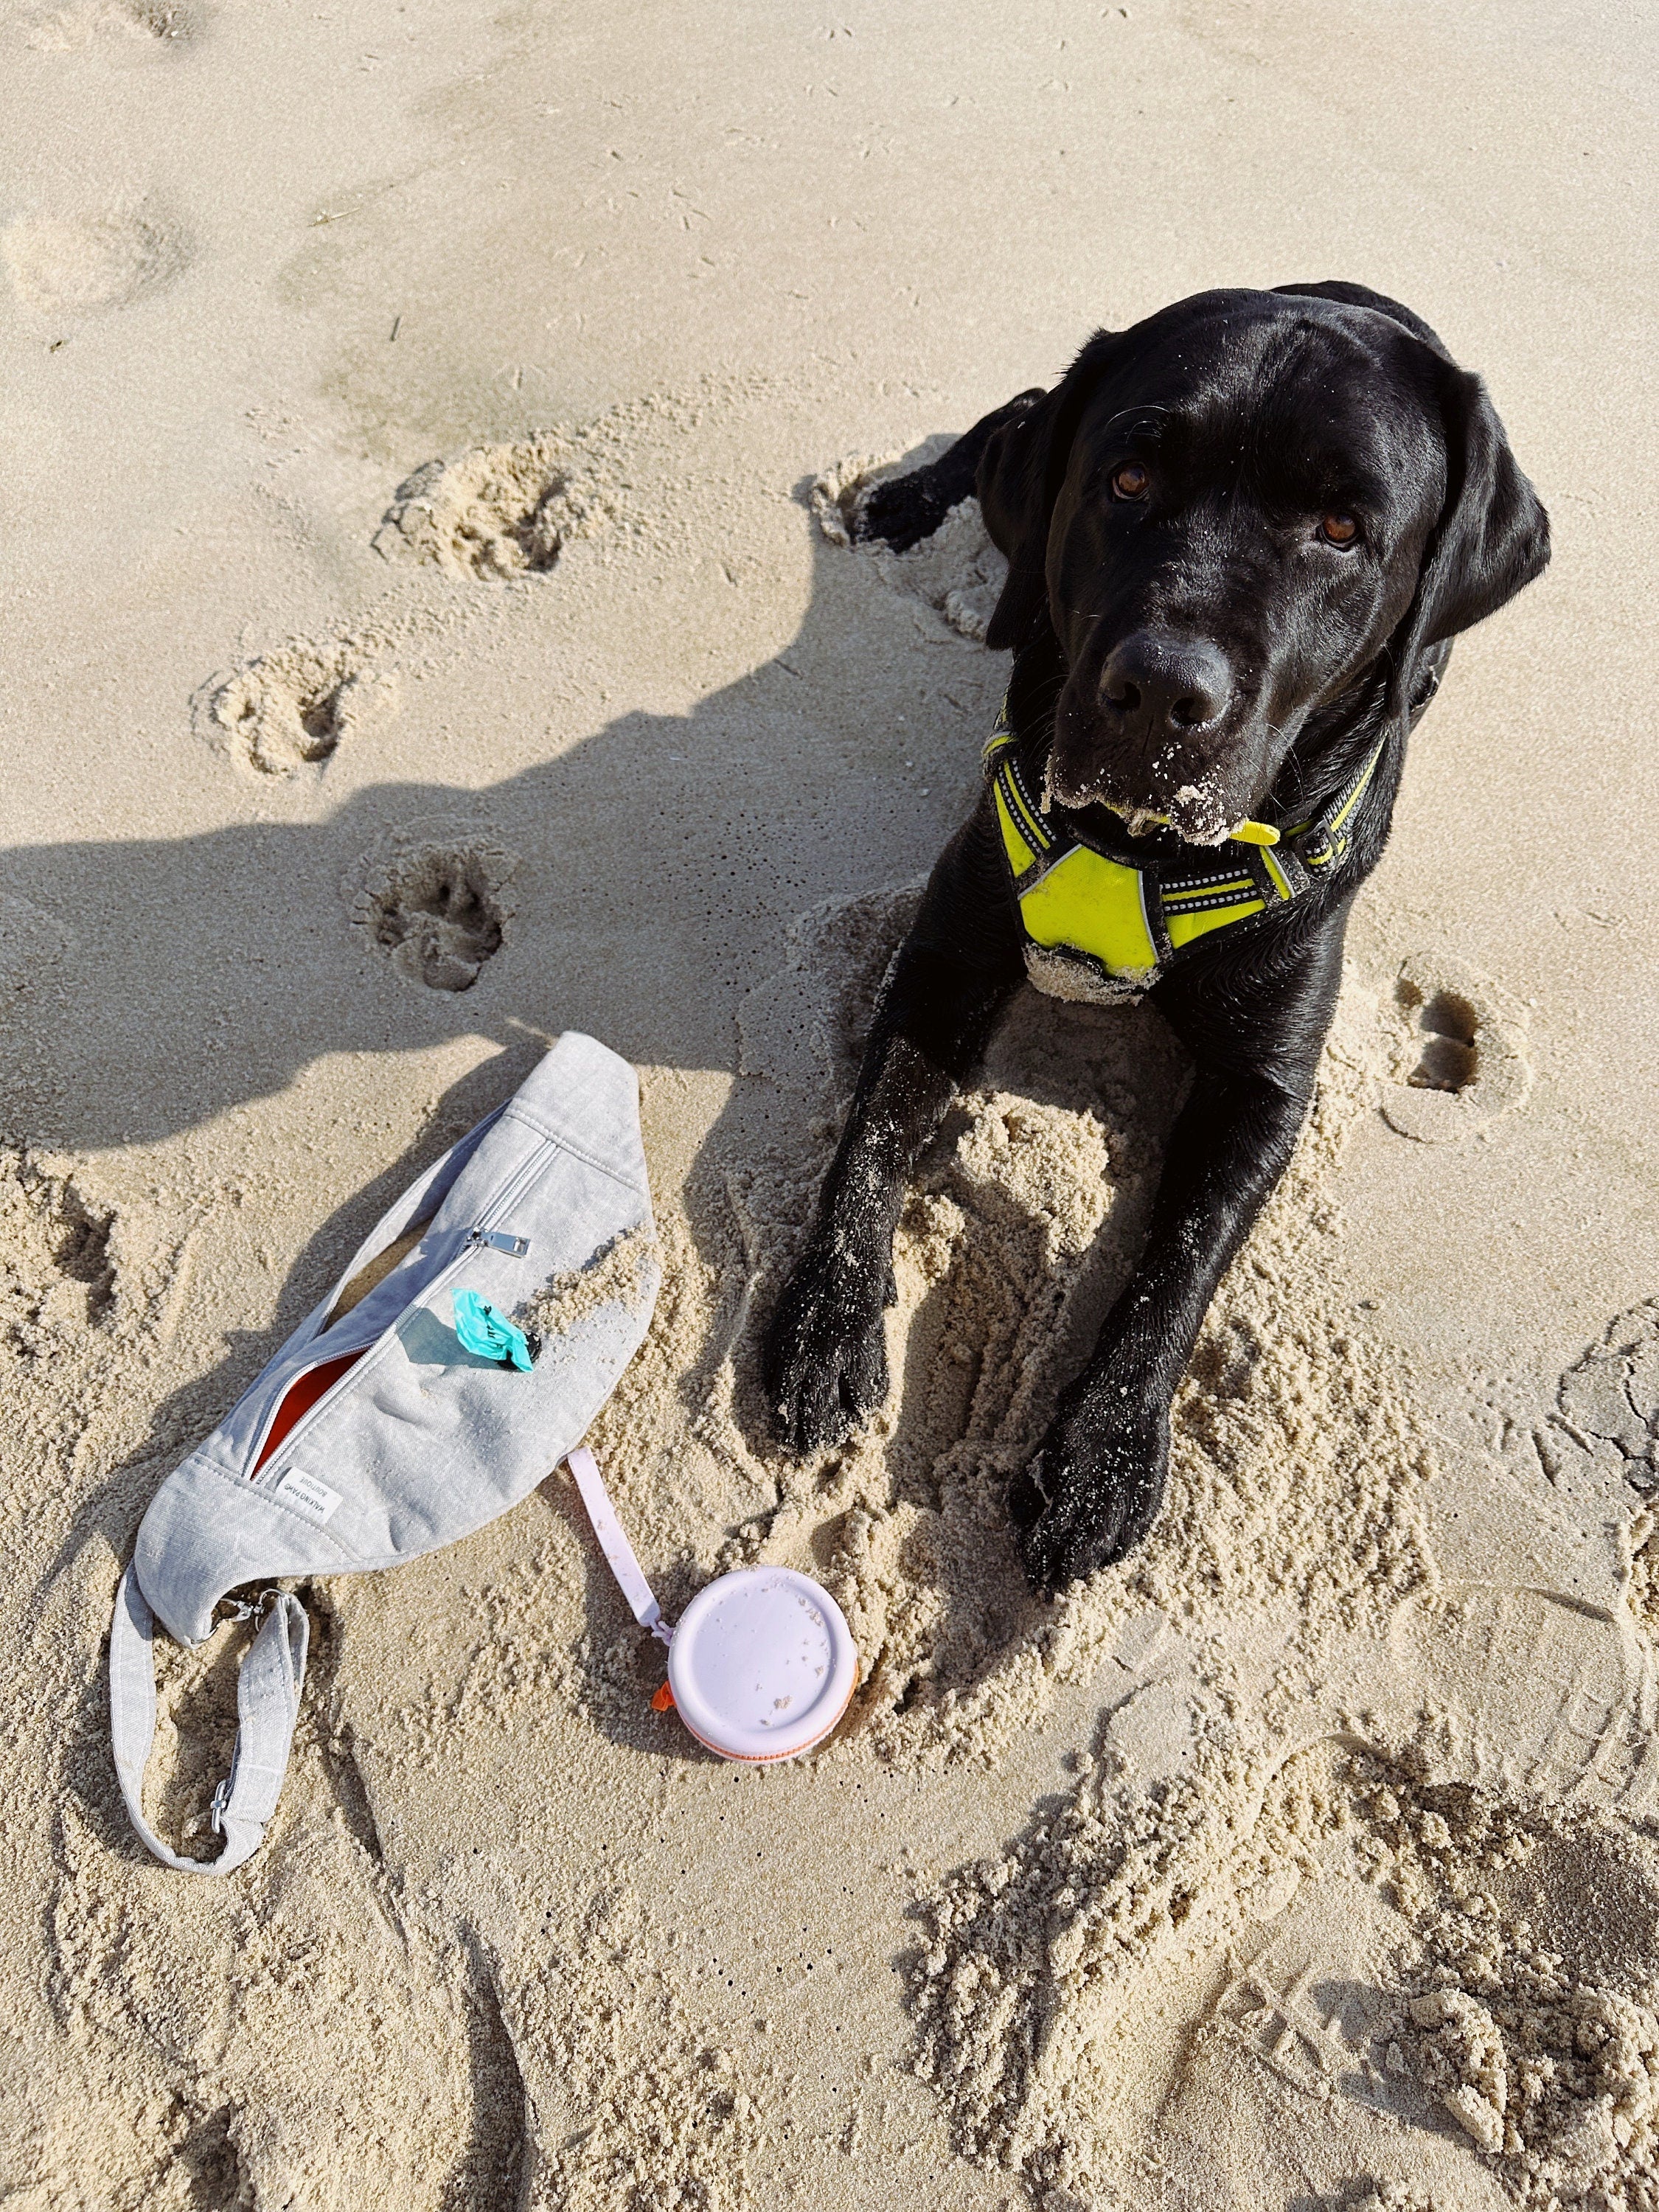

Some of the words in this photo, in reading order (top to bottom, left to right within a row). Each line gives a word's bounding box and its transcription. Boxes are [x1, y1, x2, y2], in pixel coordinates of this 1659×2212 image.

[284, 1483, 299, 1497] PAWS
[299, 1477, 327, 1497] BOUTIQUE
[300, 1494, 325, 1513] WALKING
